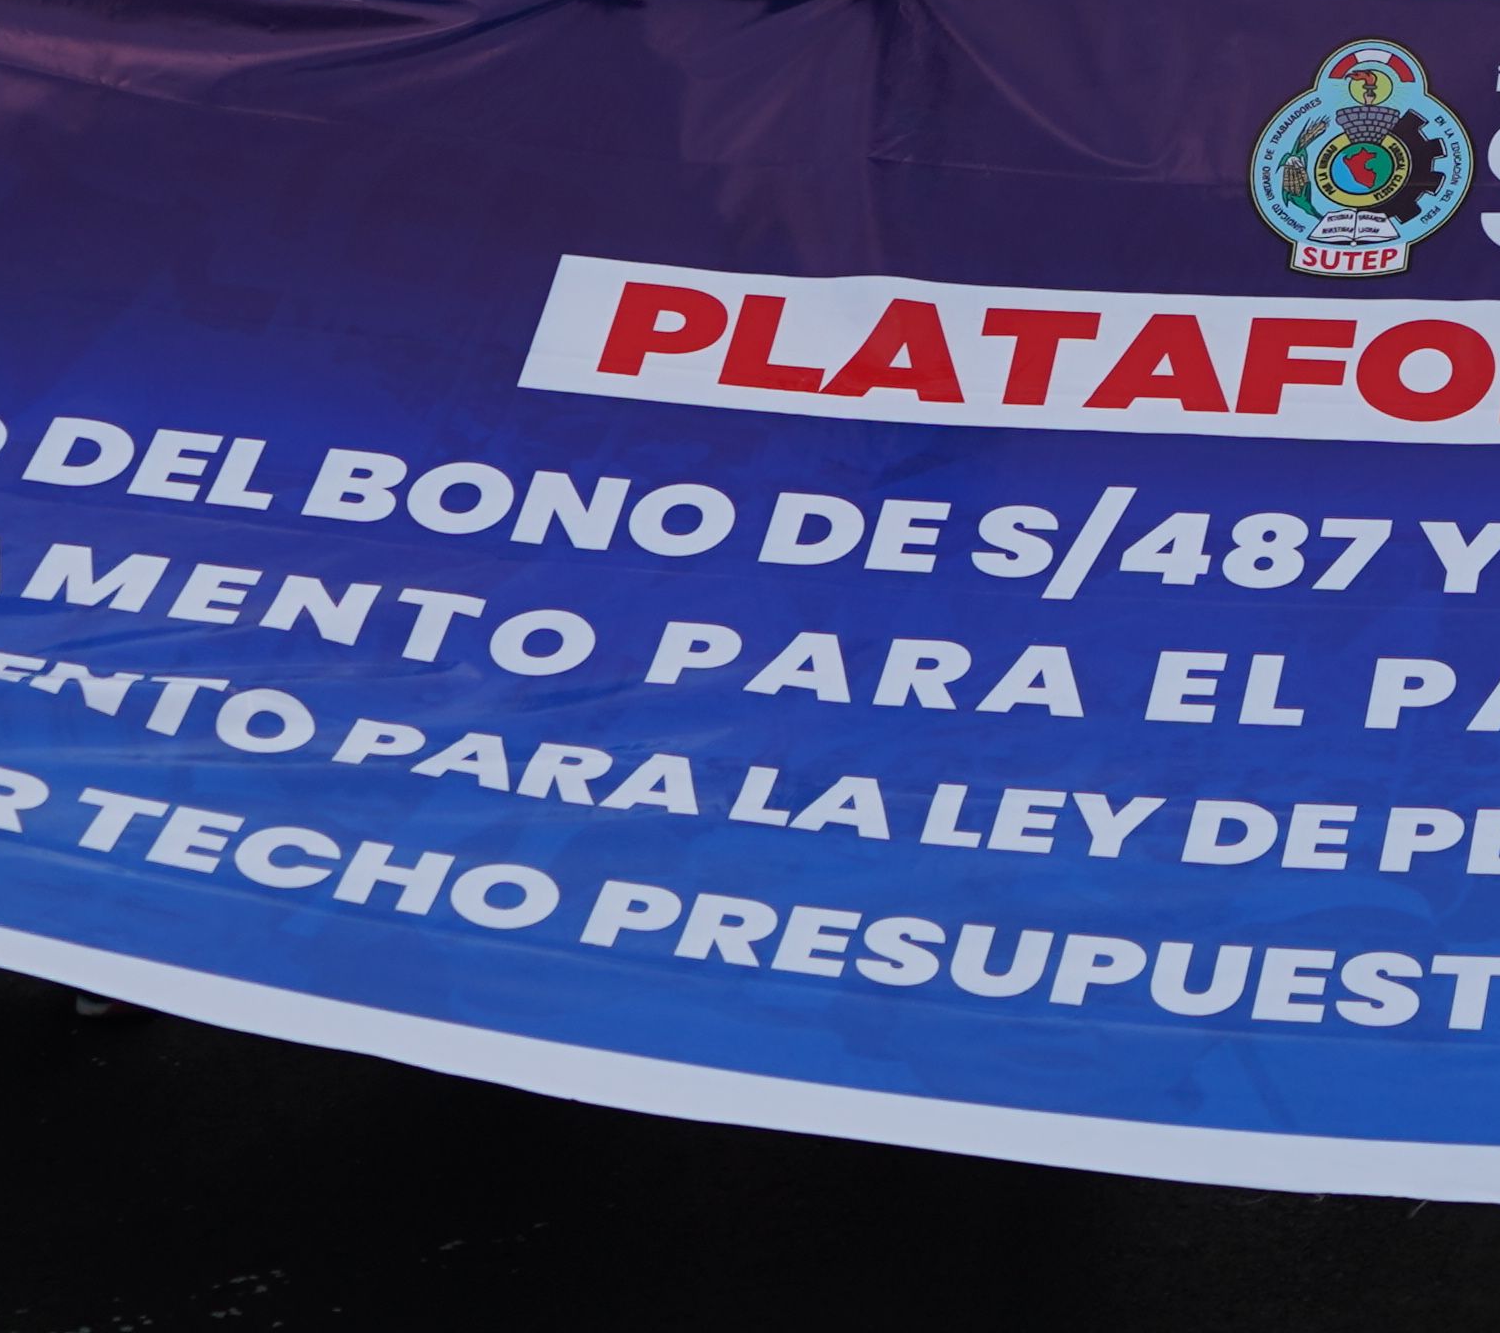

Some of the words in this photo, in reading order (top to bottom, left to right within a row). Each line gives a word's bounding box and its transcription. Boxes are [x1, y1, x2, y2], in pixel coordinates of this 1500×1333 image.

[1264, 148, 1275, 161] DE
[1270, 97, 1322, 145] TRABAJADORES
[1439, 189, 1454, 203] DEL
[1302, 246, 1398, 271] SUTEP
[21, 415, 275, 512] DEL
[301, 447, 737, 559] BONO
[757, 491, 954, 575] DE
[970, 485, 1393, 601] S/487
[643, 620, 1085, 719] PARA
[1144, 648, 1306, 727] EL
[331, 718, 700, 816] PARA
[728, 765, 890, 841] LA
[919, 782, 1167, 859] LEY
[1180, 799, 1358, 871] DE
[77, 786, 561, 931] TECHO
